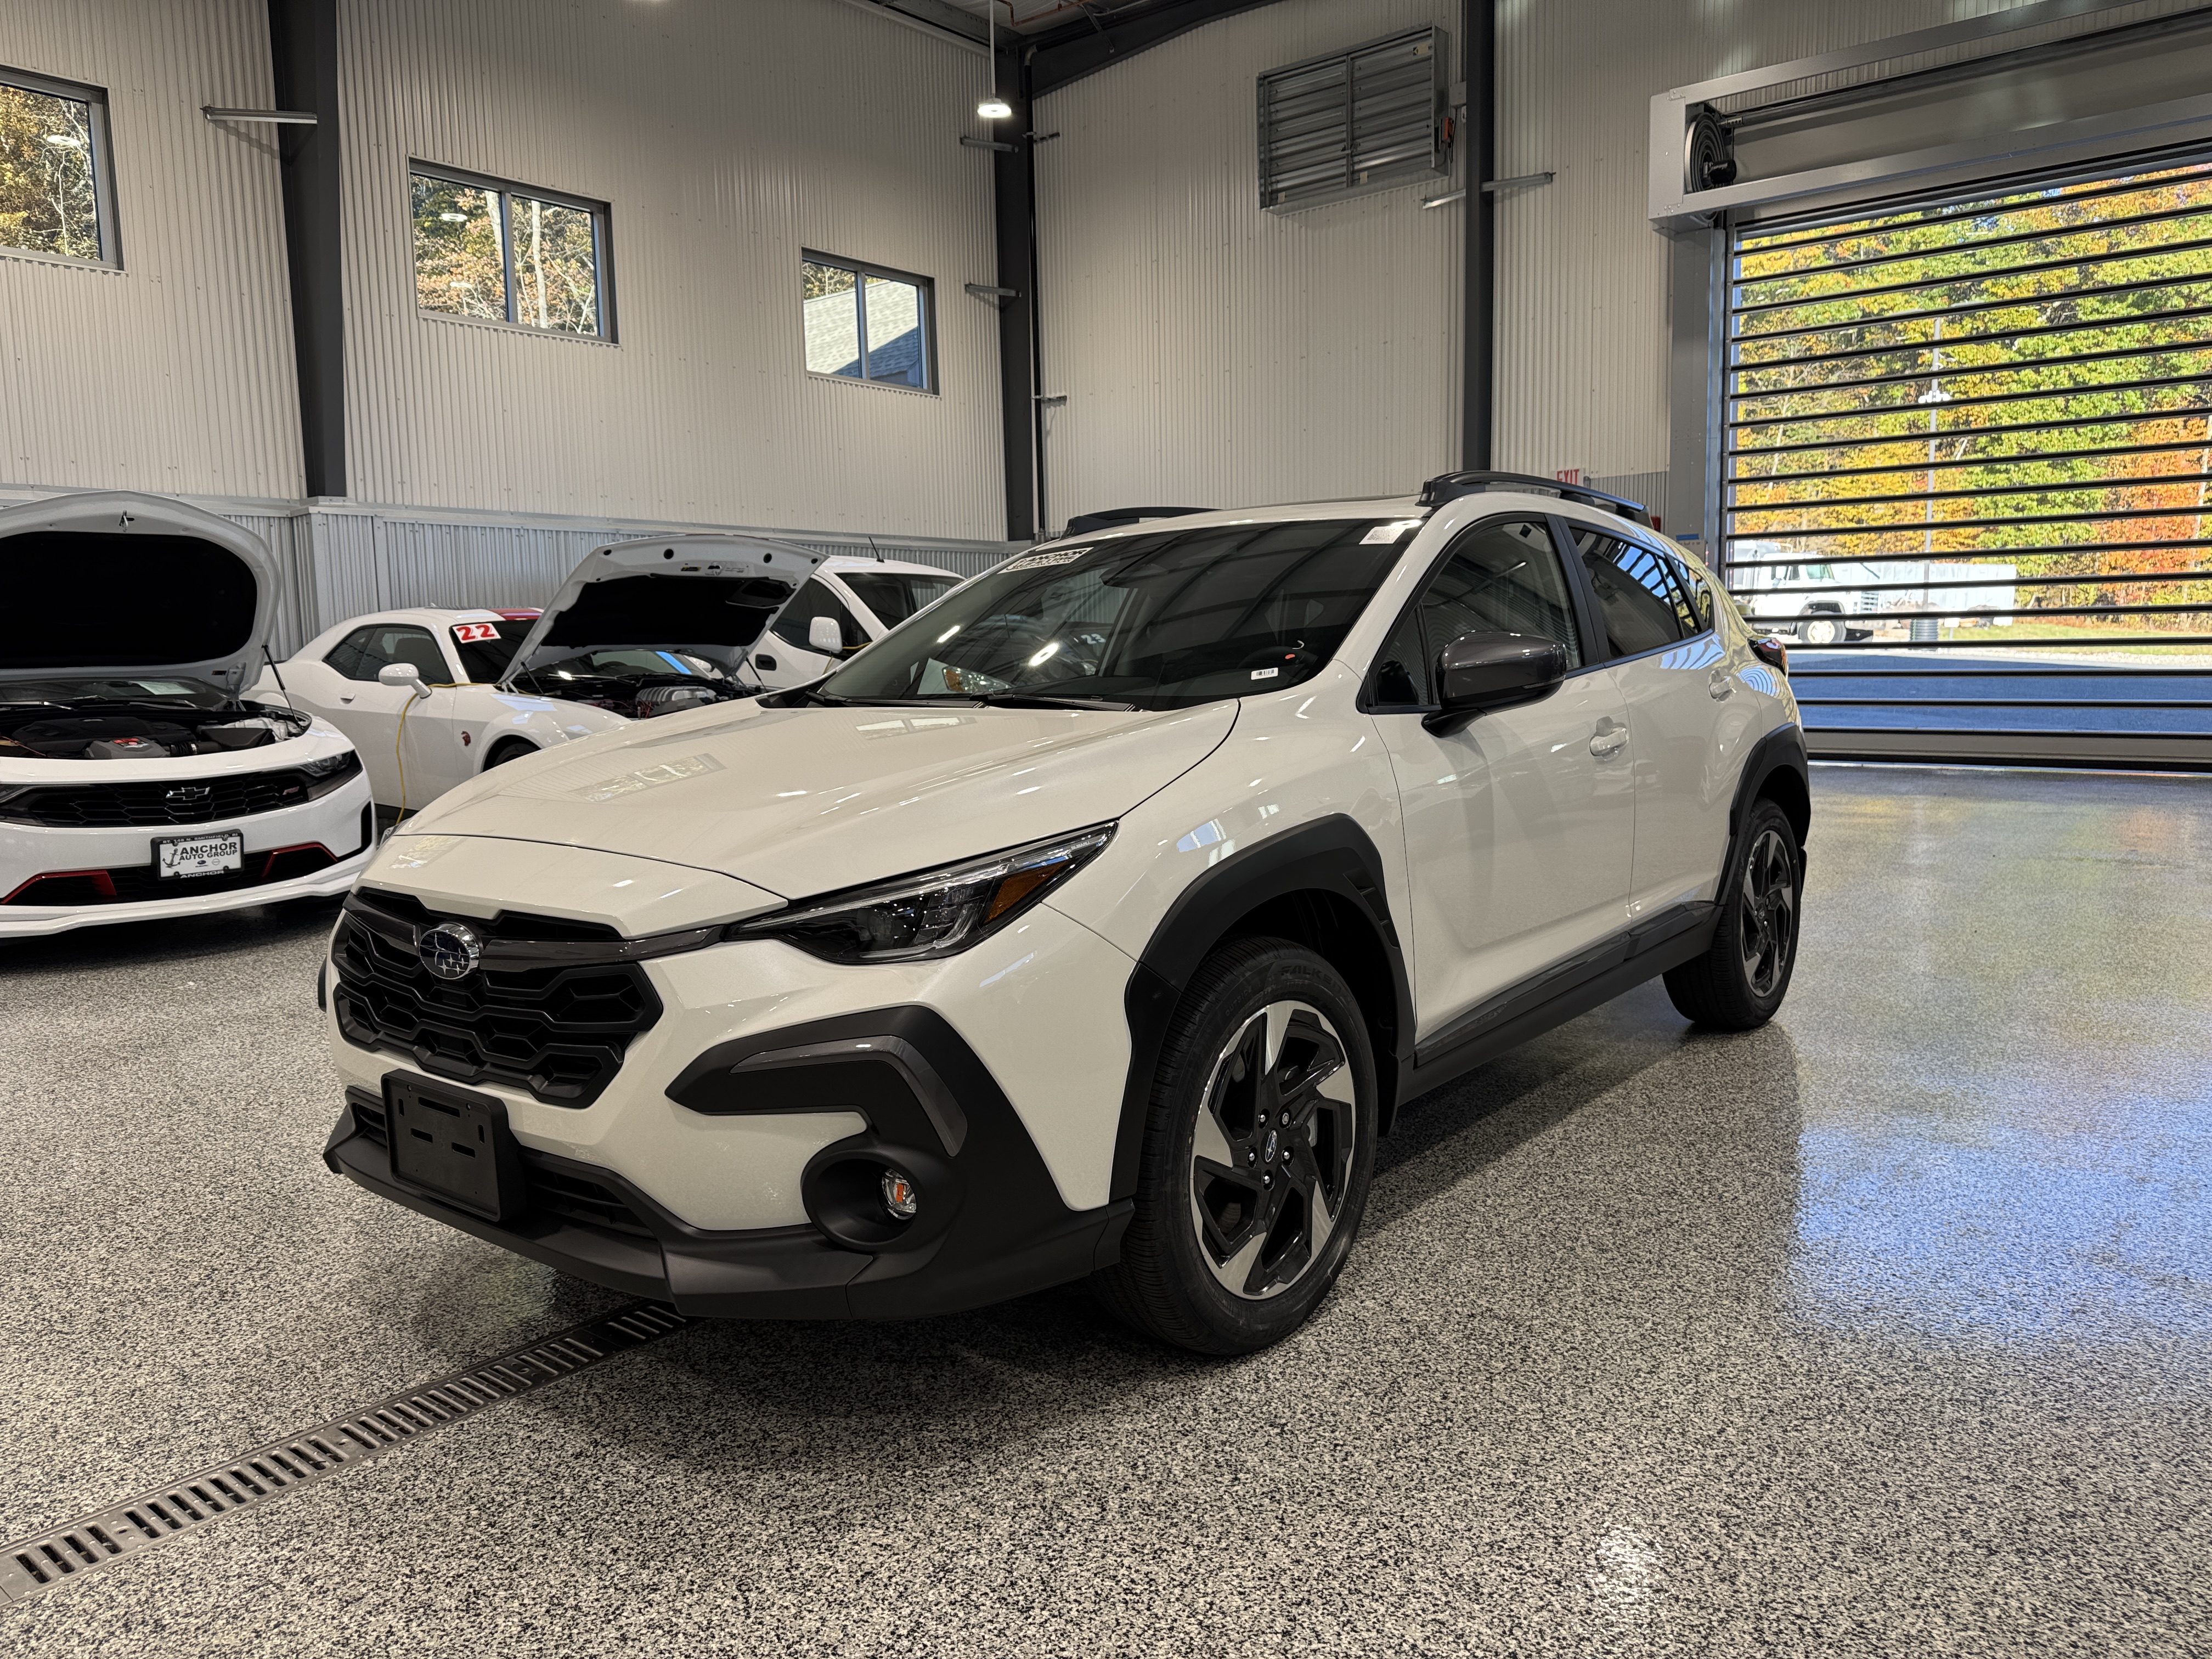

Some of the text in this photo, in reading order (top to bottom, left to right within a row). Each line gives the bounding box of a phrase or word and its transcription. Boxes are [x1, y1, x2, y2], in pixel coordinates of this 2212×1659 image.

[1557, 469, 1579, 486] EXIT
[1028, 549, 1088, 562] ANCHOR
[456, 624, 495, 641] 22
[1080, 633, 1106, 644] 23
[180, 842, 238, 855] ANCHOR
[207, 850, 238, 858] GROUP
[180, 870, 224, 878] ANCHOR
